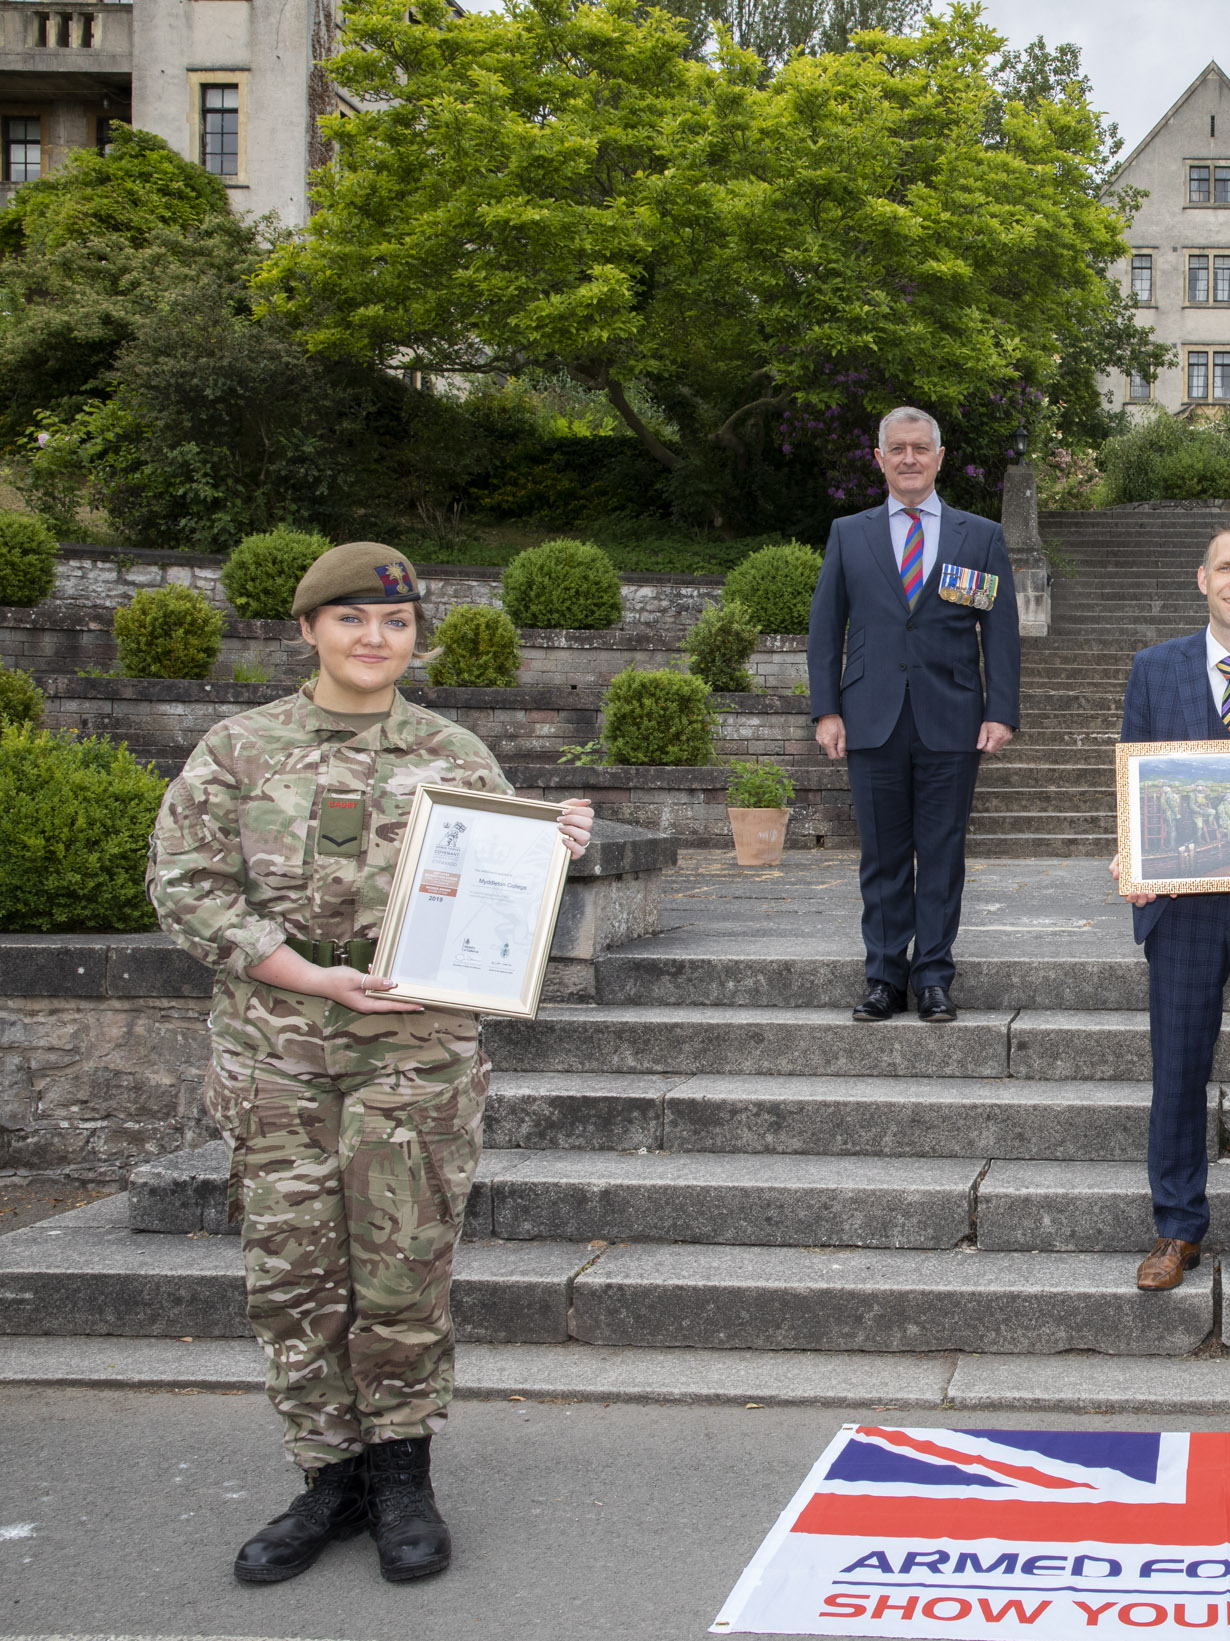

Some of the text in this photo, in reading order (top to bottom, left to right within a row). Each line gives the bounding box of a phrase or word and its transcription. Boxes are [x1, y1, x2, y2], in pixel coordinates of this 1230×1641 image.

[328, 800, 357, 808] CADET
[839, 1550, 1123, 1579] ARMED
[819, 1593, 1053, 1625] SHOW
